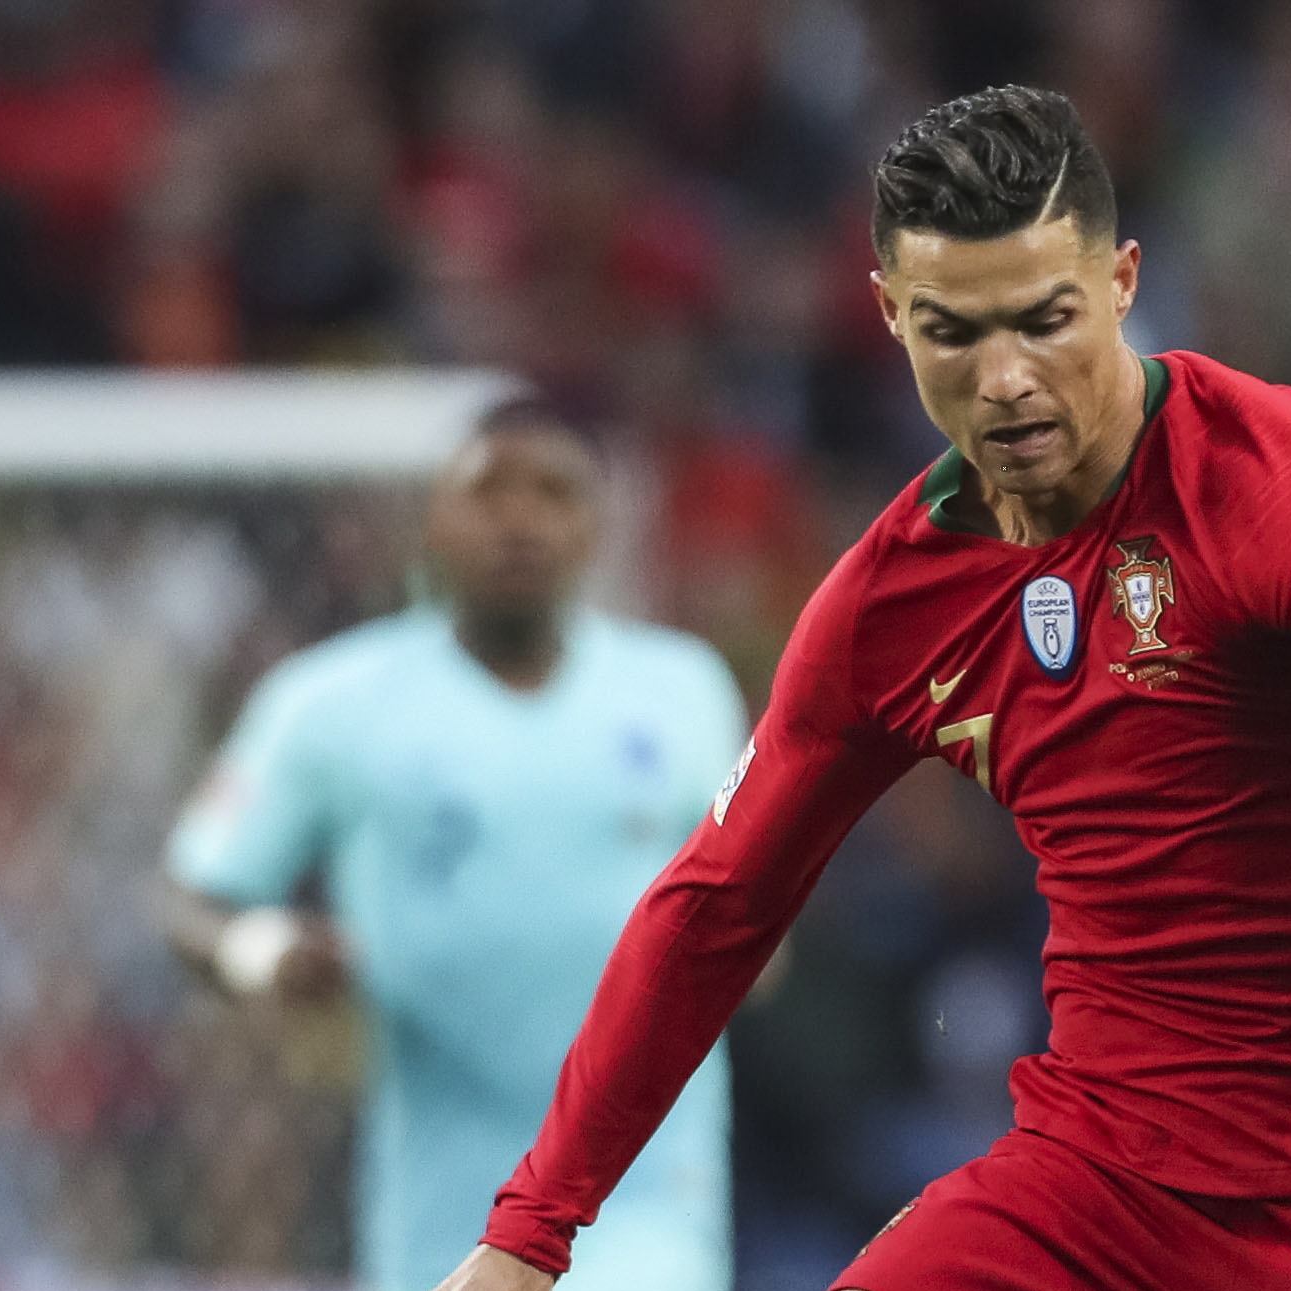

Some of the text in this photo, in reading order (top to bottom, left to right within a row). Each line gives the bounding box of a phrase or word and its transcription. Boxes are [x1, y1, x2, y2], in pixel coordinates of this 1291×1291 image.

[1028, 599, 1070, 608] EUROPEAN
[1028, 609, 1070, 617] CHAMPIONS
[935, 713, 994, 793] 7
